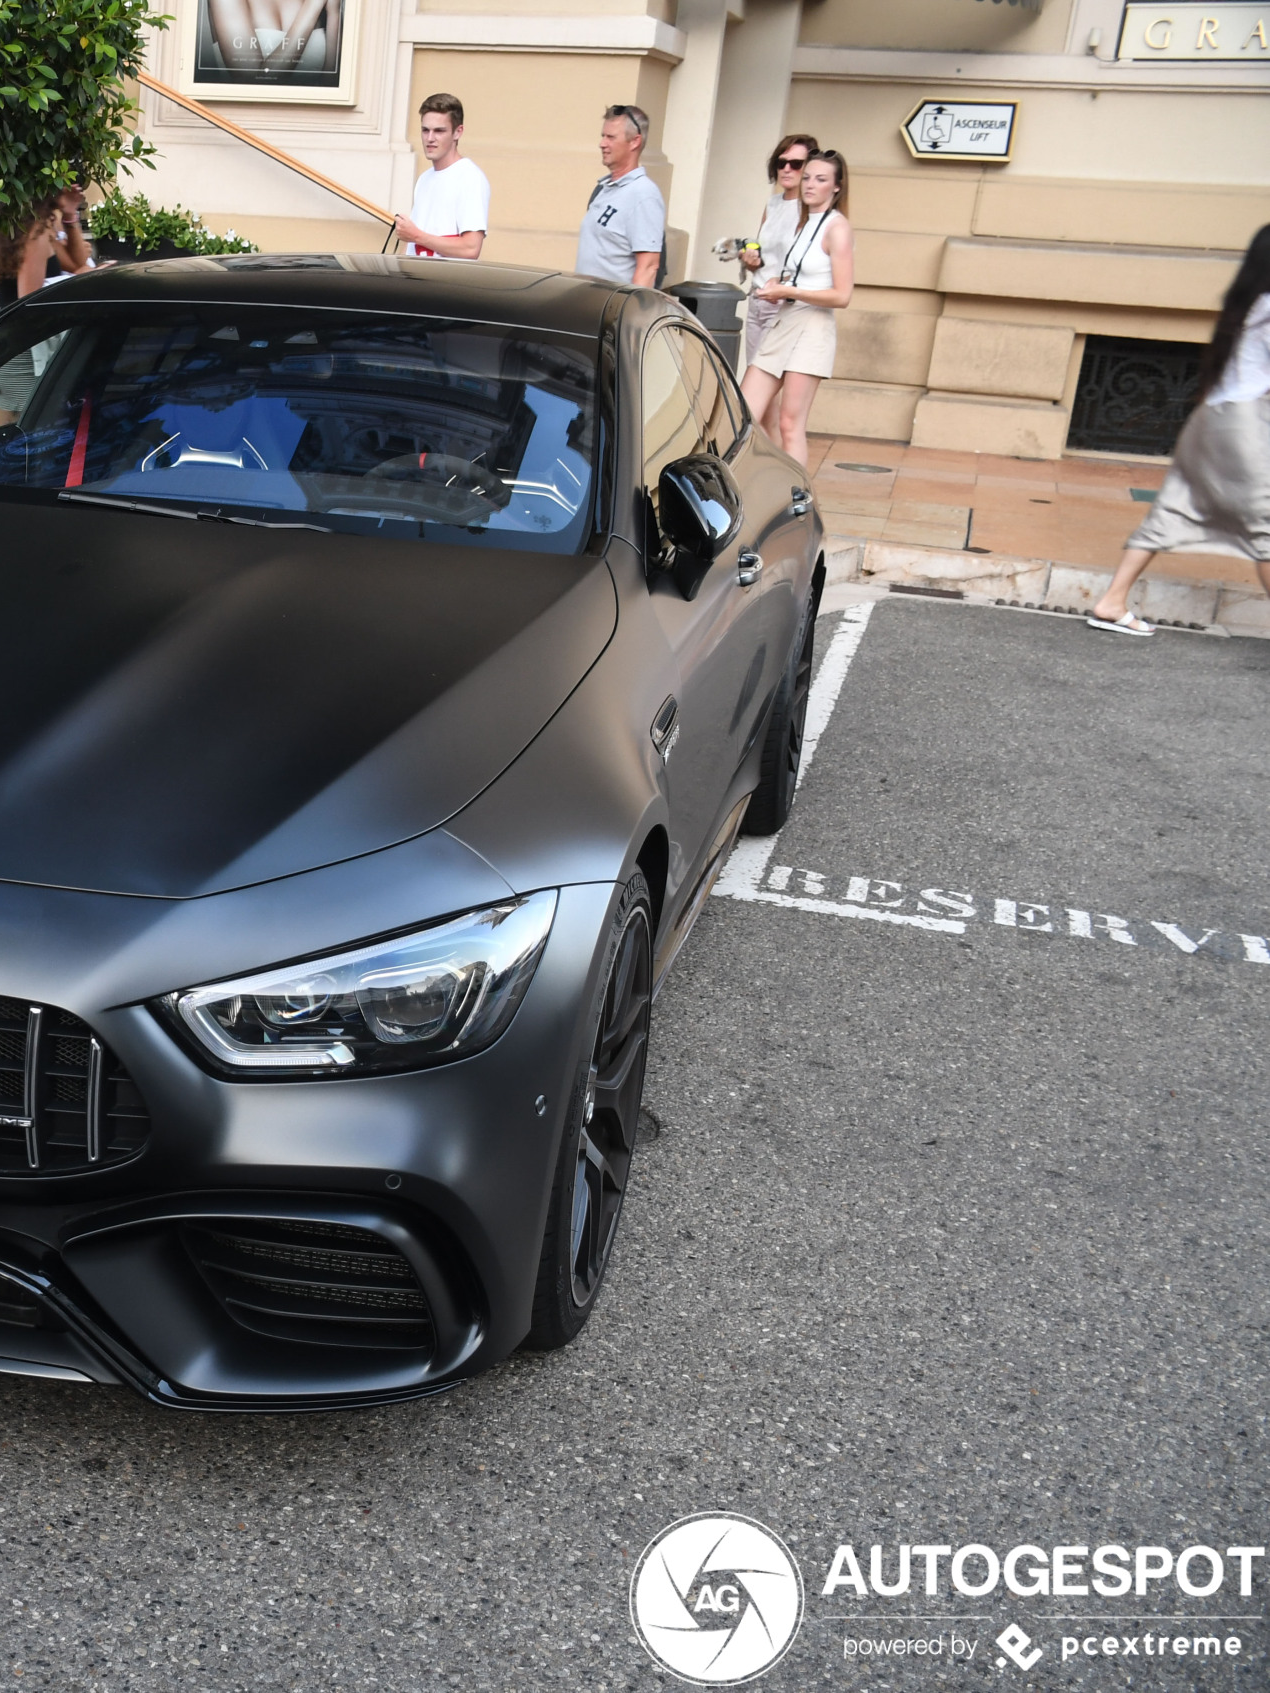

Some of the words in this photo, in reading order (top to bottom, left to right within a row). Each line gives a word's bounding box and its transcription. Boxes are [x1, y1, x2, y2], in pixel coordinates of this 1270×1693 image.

[232, 36, 305, 51] GRAFF
[954, 119, 1007, 130] ASCENSEUR
[969, 132, 990, 142] LIFT
[597, 205, 618, 227] H
